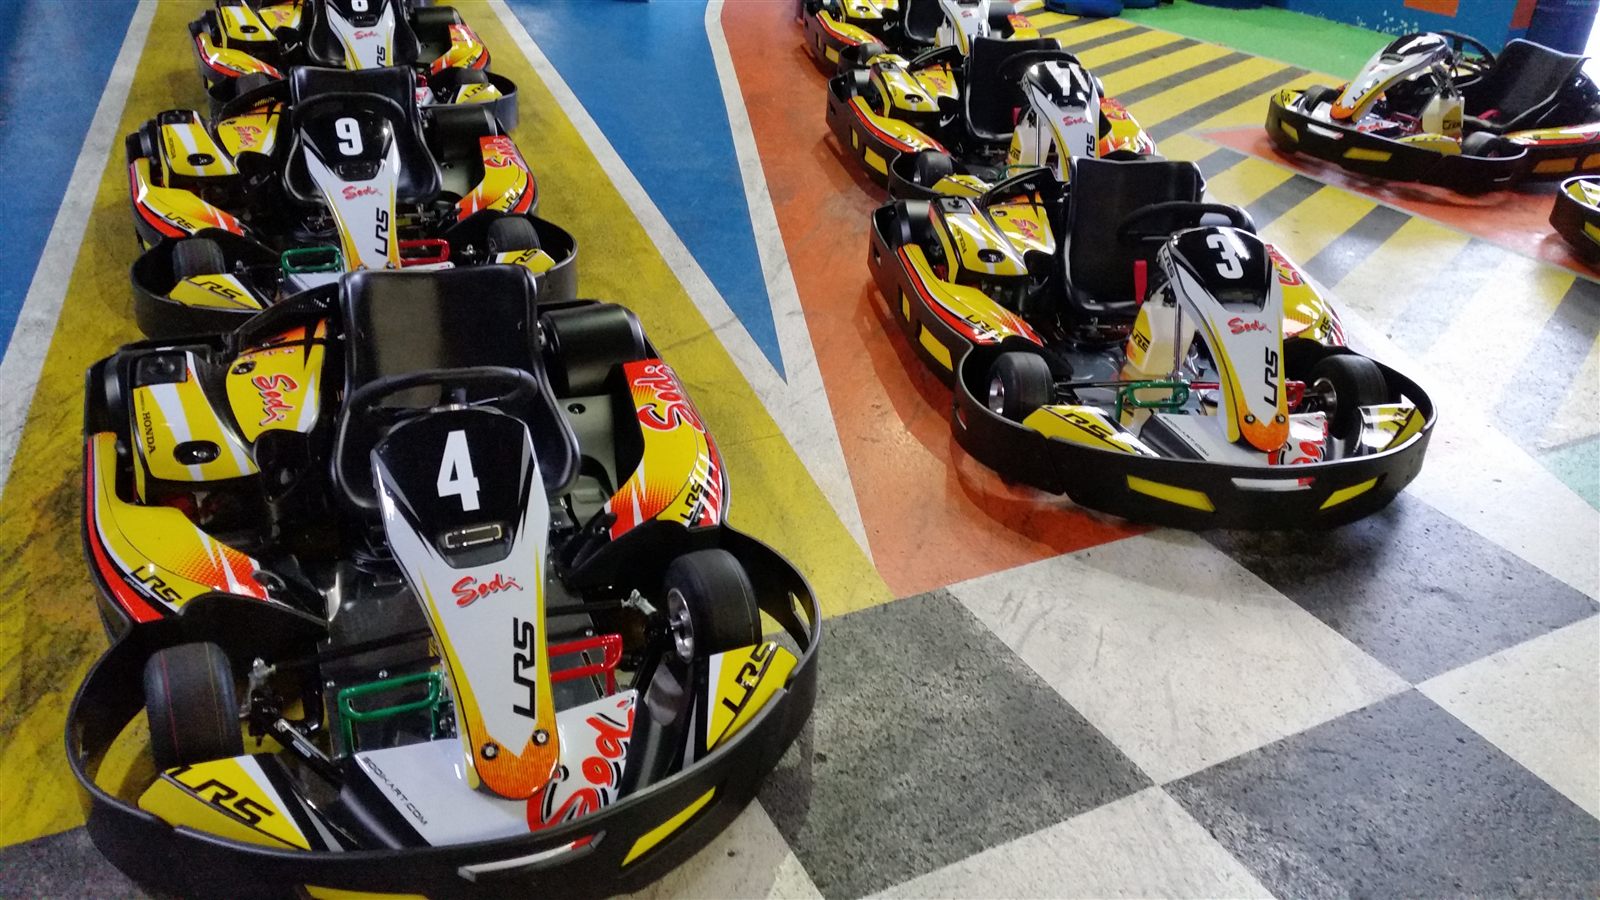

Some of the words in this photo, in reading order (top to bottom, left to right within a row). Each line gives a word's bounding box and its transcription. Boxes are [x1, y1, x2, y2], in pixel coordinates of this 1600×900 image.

[377, 45, 386, 68] RS
[335, 117, 363, 156] 9
[1086, 132, 1096, 158] RS
[164, 212, 196, 230] LRS
[374, 207, 389, 257] LRS
[1206, 233, 1244, 279] 3
[1317, 317, 1332, 341] RS
[1263, 346, 1279, 408] LRS
[251, 373, 299, 427] Sodi
[142, 411, 156, 454] HONDA
[437, 429, 480, 512] 4
[679, 480, 705, 521] LRS
[129, 564, 183, 603] LRS
[451, 573, 523, 608] Sodi
[513, 617, 536, 719] LRS
[167, 764, 275, 828] LRS
